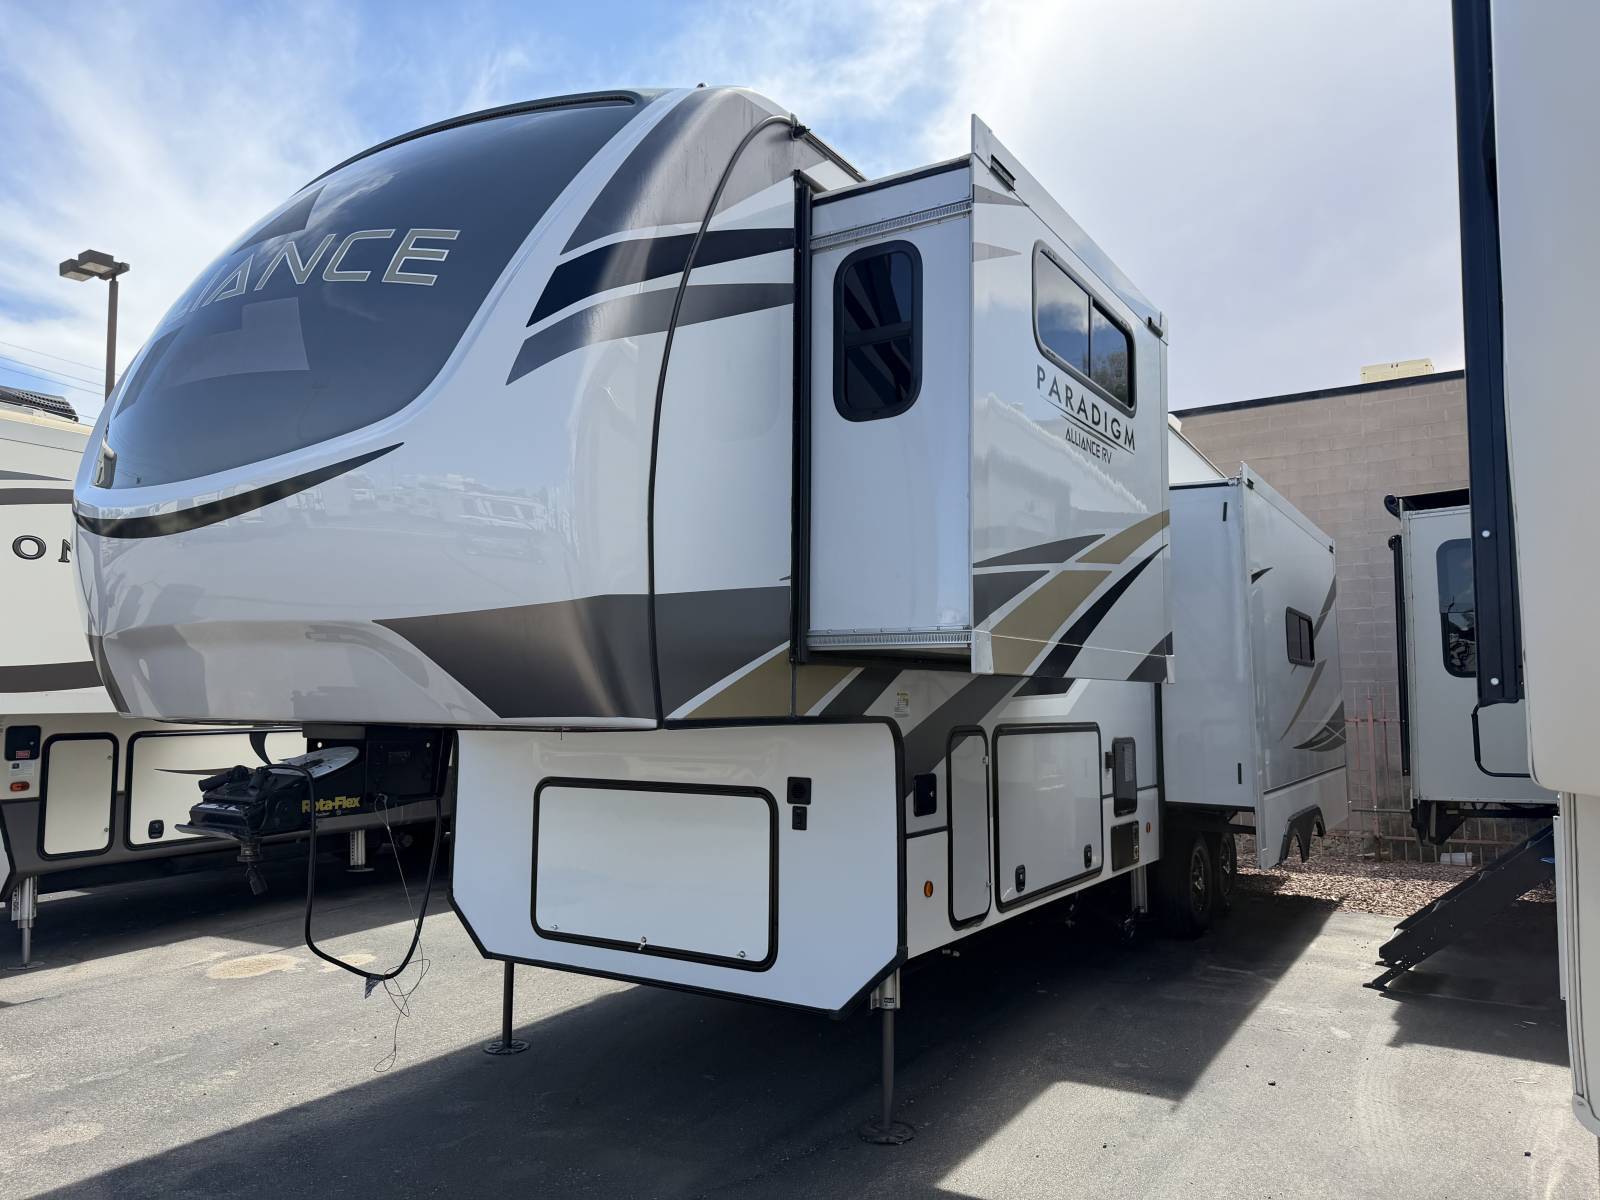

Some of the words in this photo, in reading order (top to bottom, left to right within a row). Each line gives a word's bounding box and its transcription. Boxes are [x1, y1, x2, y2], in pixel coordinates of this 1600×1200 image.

[1036, 364, 1136, 451] PARADIGM
[1065, 427, 1101, 459] ALLIANCE
[1102, 446, 1112, 464] RV
